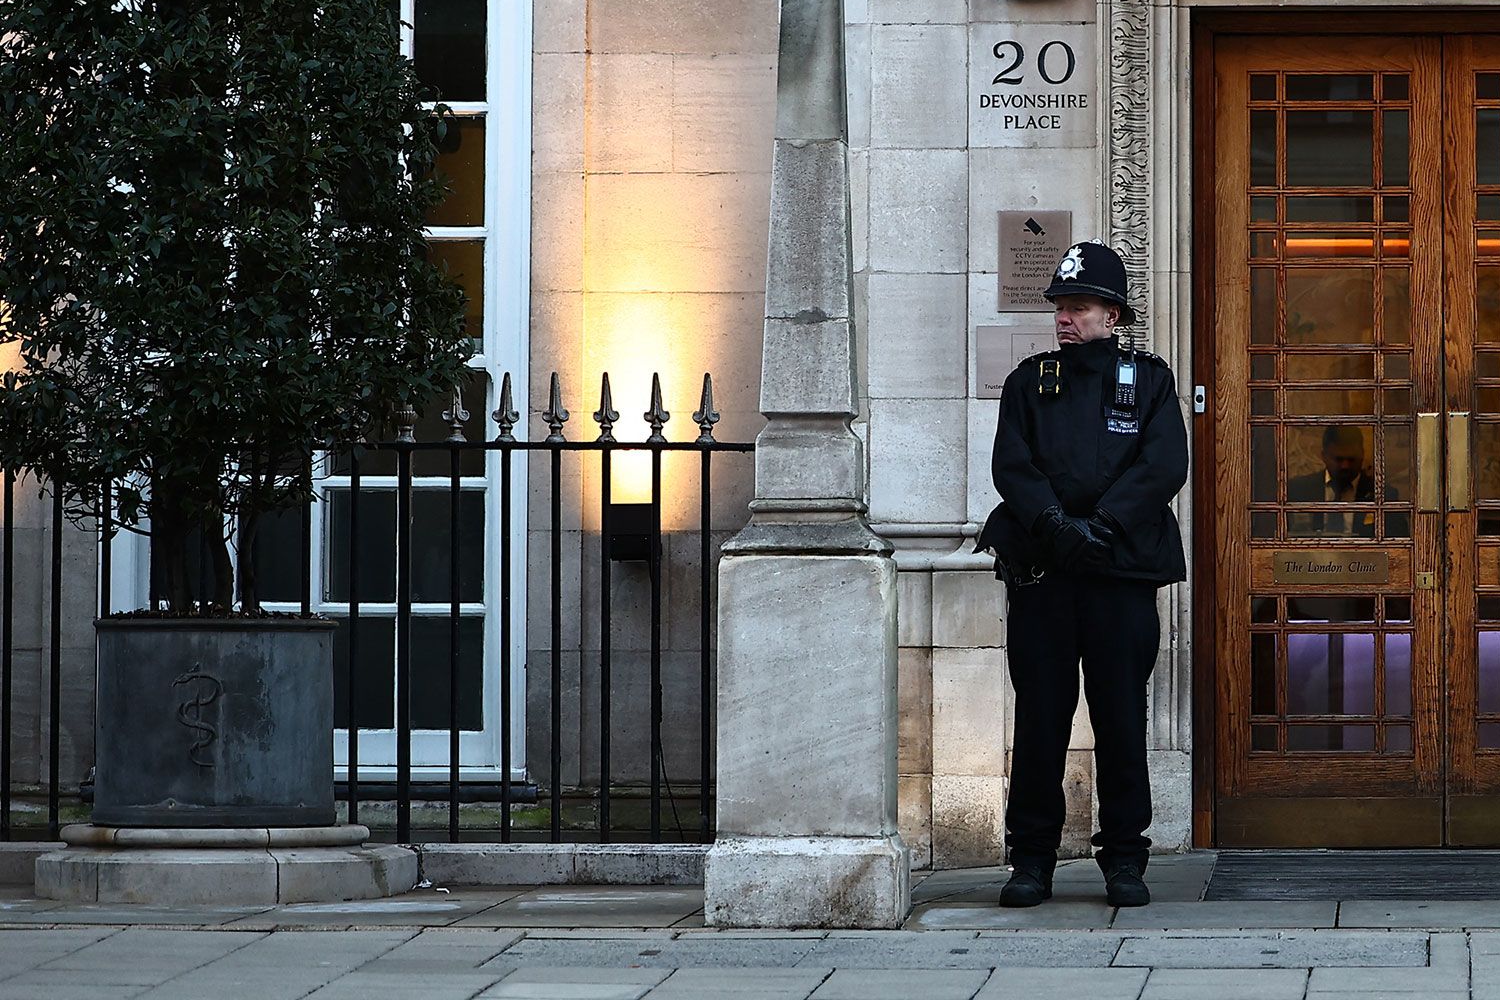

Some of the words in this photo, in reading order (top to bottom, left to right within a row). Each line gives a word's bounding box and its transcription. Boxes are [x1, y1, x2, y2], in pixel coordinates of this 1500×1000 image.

[992, 40, 1076, 85] 20
[980, 94, 1088, 108] DEVONSHIRE
[1004, 115, 1061, 129] PLACE
[1285, 561, 1303, 573] The
[1307, 561, 1343, 573] London
[1348, 561, 1377, 572] Clinic
